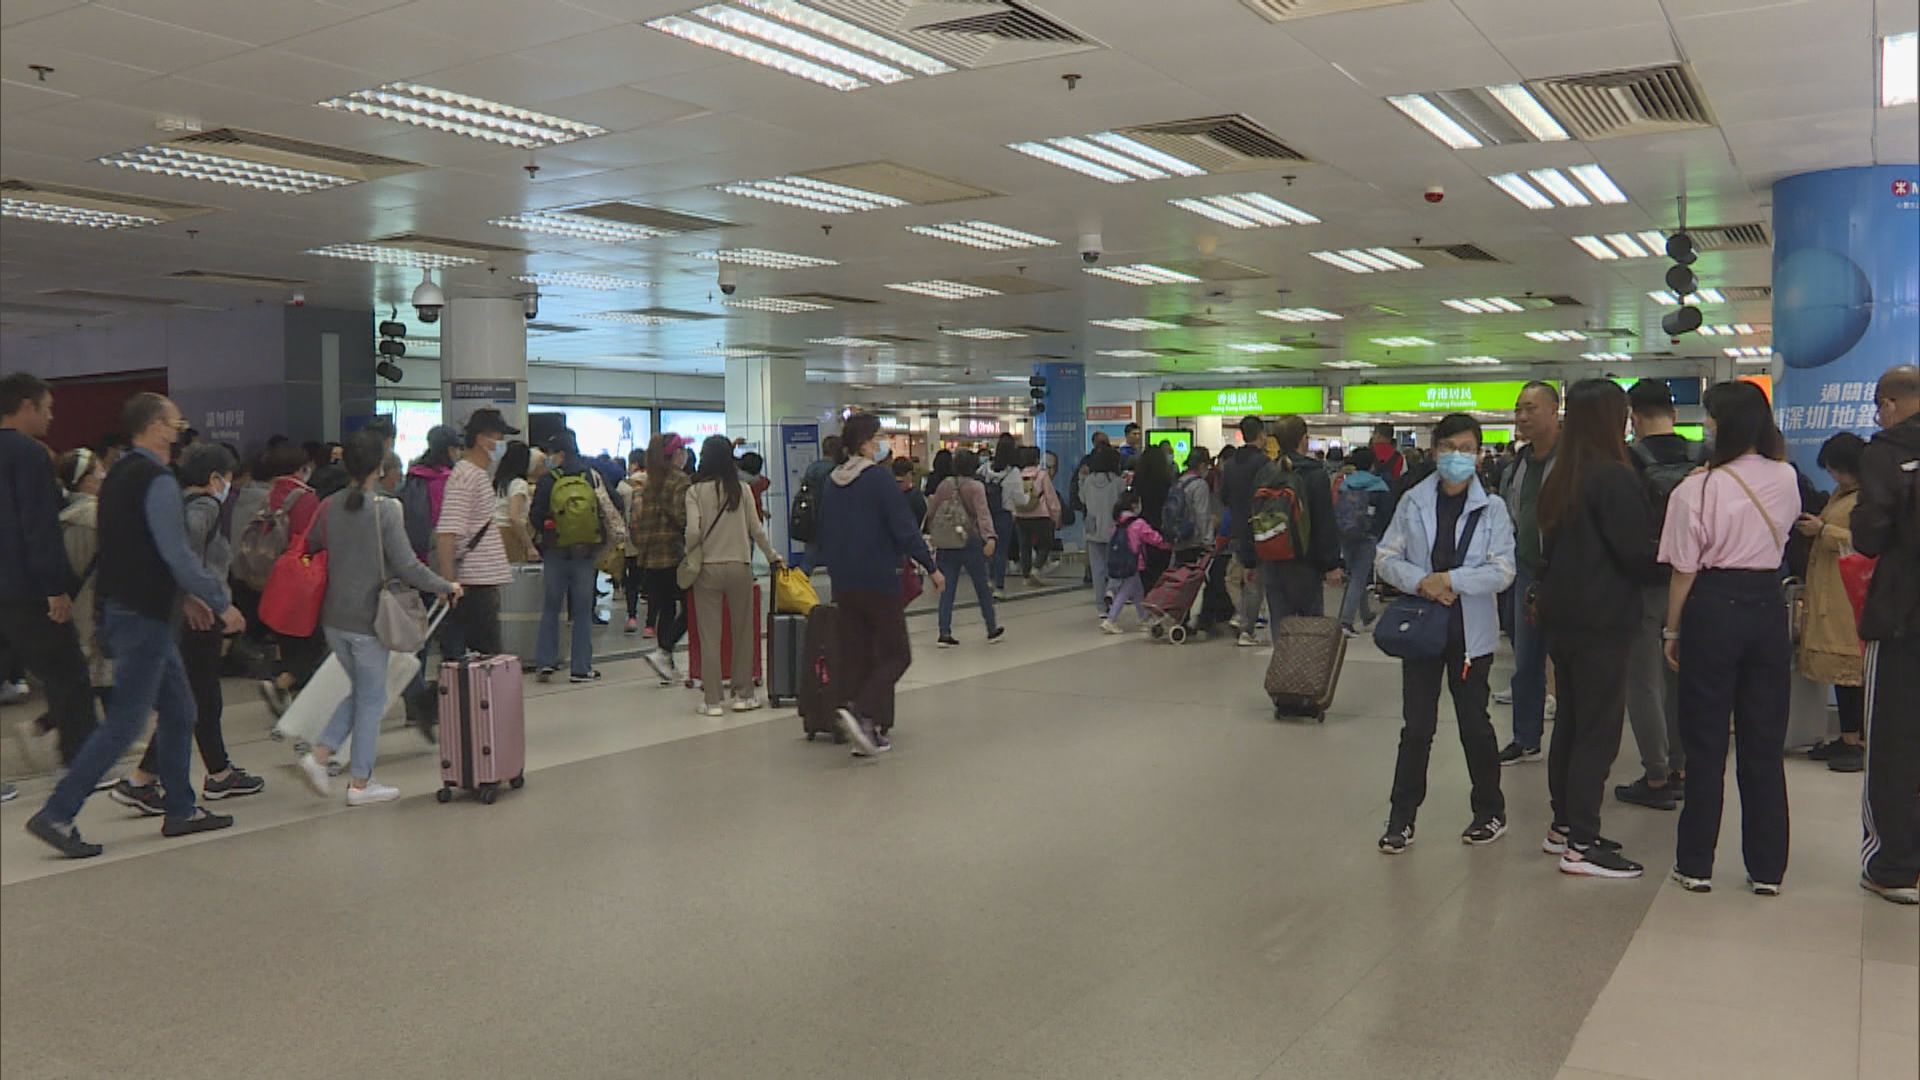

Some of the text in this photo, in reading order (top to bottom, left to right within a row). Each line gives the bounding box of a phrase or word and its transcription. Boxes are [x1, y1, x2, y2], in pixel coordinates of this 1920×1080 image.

[1217, 391, 1258, 405] 香港居民
[1426, 387, 1472, 400] 香港居民
